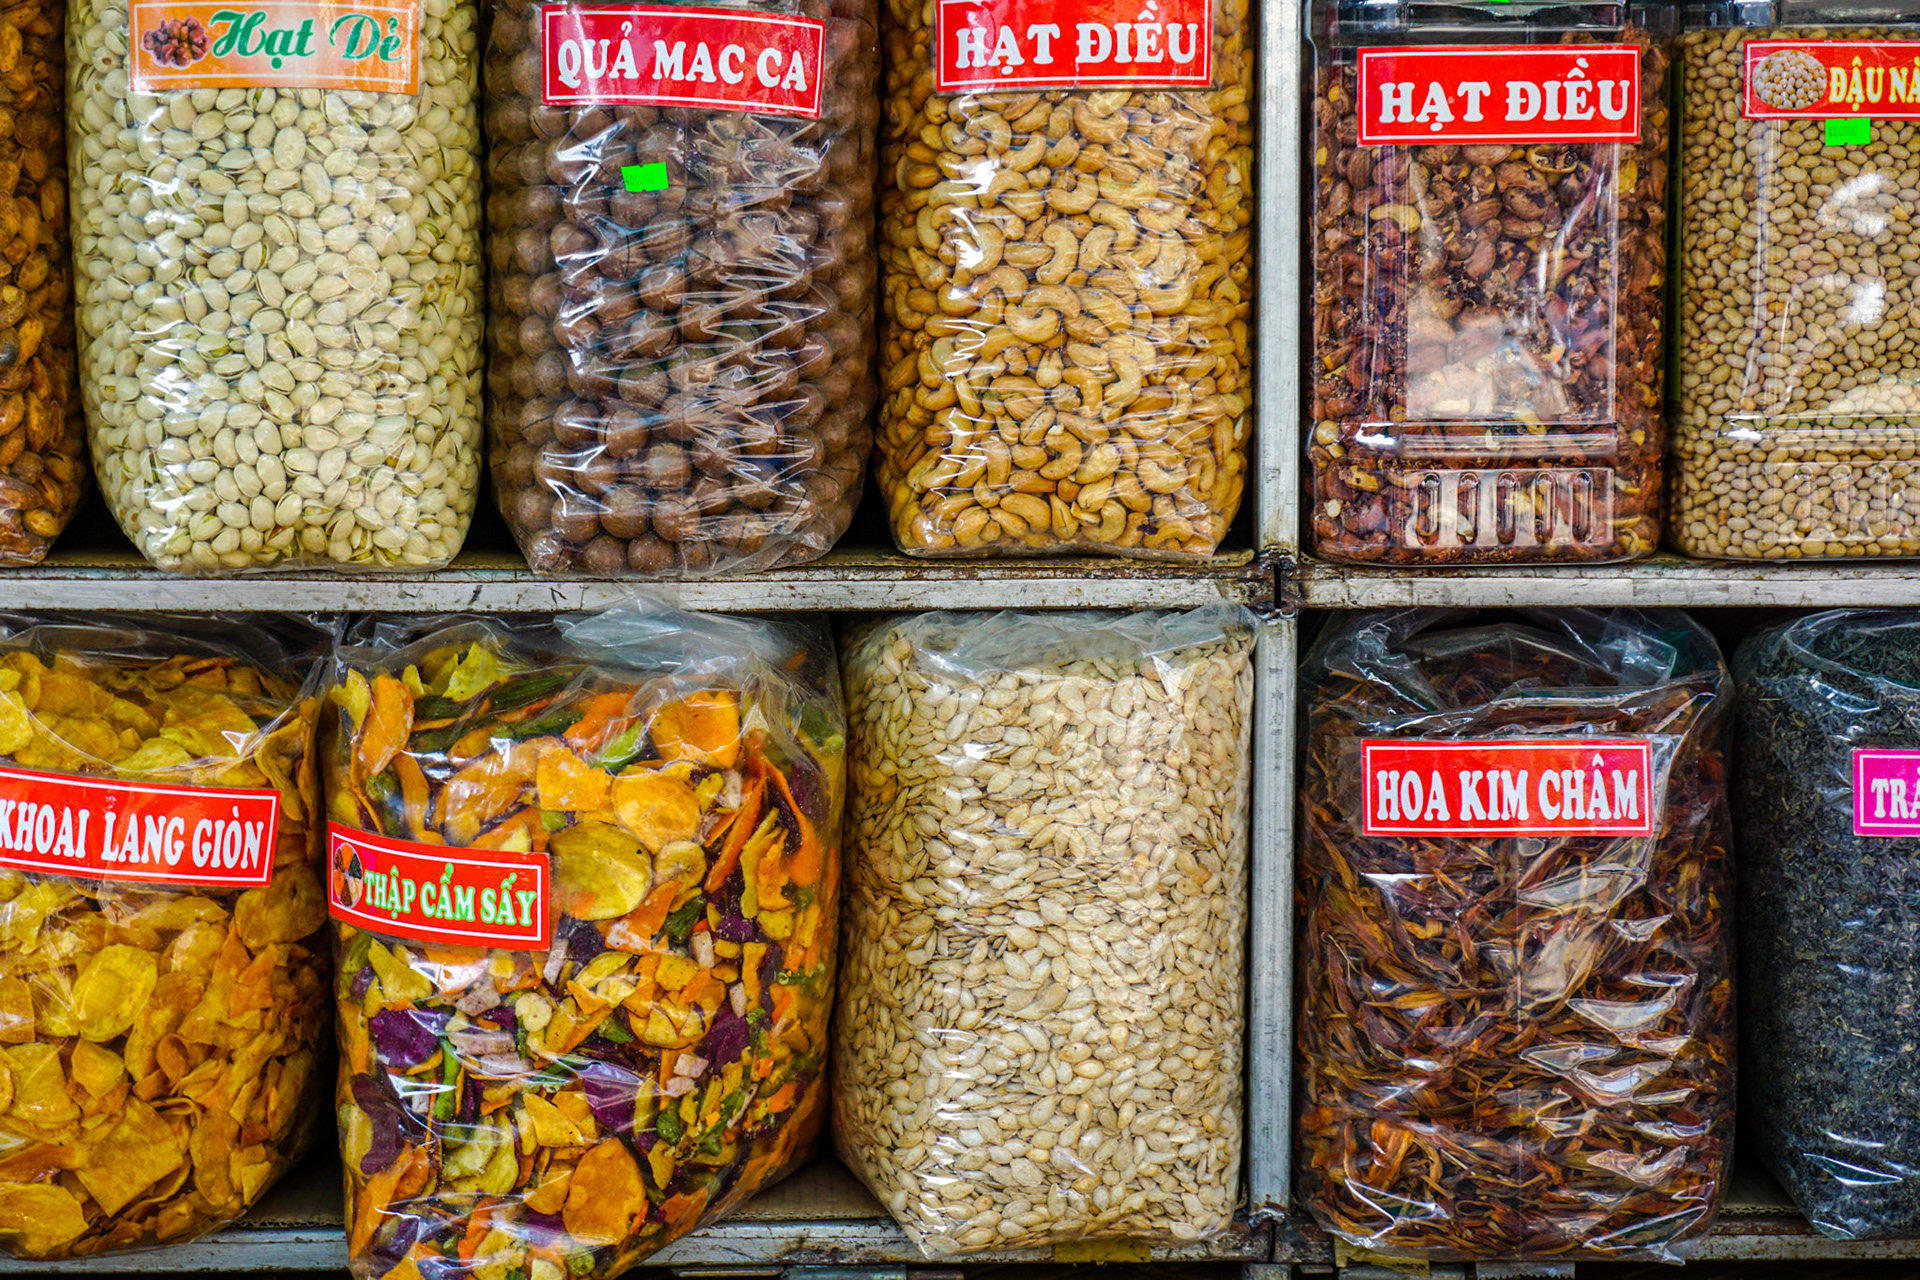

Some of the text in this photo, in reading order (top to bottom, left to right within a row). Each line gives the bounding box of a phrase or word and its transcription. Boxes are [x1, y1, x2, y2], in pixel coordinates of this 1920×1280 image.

[209, 11, 403, 69] Hạt Dẻ
[558, 21, 808, 92] QUẢ MAC CA
[956, 0, 1198, 75] HẠT ĐIỀU
[1379, 57, 1630, 132] HẠT ĐIỀU
[1829, 55, 1885, 112] ĐẬU
[1377, 753, 1640, 821] HOA KIM CHÂM
[0, 798, 264, 869] KHOAI LANG GIÒN
[364, 862, 537, 926] THẬP CẨM SẤY
